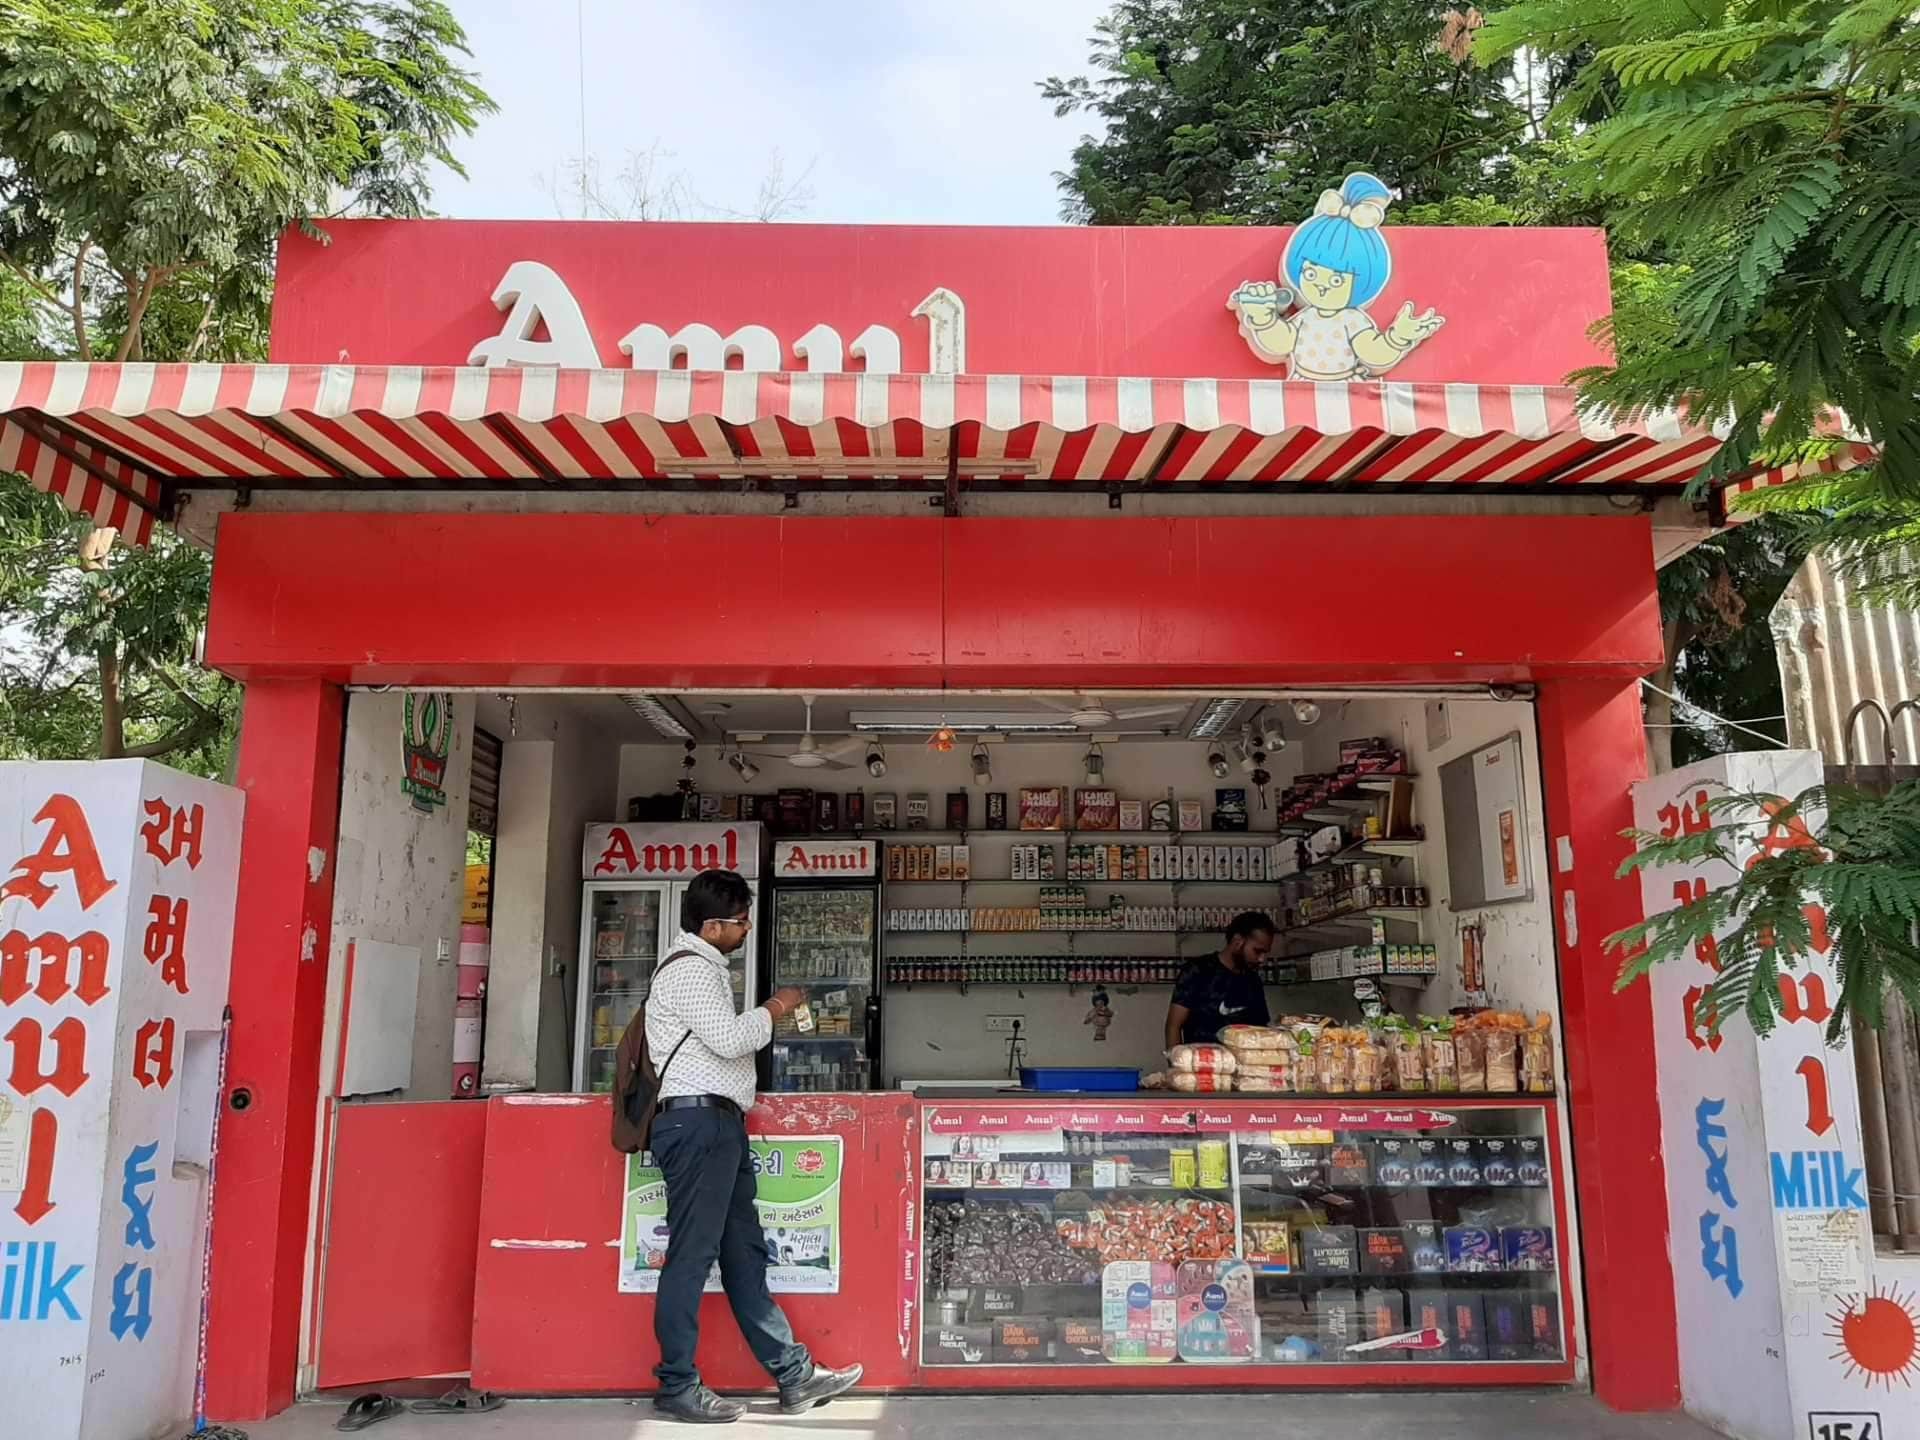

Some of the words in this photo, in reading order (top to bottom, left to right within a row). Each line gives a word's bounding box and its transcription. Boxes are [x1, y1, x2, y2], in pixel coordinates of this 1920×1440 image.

[594, 827, 738, 876] Amul
[783, 846, 869, 871] Amul
[133, 797, 206, 1092] અમૂલ
[0, 793, 118, 1226] Amul
[933, 1114, 963, 1126] Amul
[979, 1114, 1008, 1125] Amul
[1024, 1114, 1053, 1124] Amul
[1070, 1113, 1099, 1124] Amul
[1115, 1114, 1144, 1124] Amul
[1160, 1114, 1185, 1124] Amu
[1203, 1114, 1232, 1124] Amul
[1248, 1113, 1277, 1123] Amul
[1294, 1113, 1323, 1123] Amul
[1339, 1113, 1368, 1123] Amul
[1384, 1112, 1413, 1122] Amul
[1770, 1151, 1868, 1208] Milk
[782, 1203, 824, 1222] અહેસાસ
[1695, 1098, 1744, 1300] દૂધ
[109, 1140, 159, 1343] દૂધ
[905, 1250, 914, 1280] Amul
[1246, 1252, 1270, 1263] Amul
[0, 1241, 85, 1321] ilk
[1205, 1291, 1225, 1300] Amul
[1003, 1327, 1024, 1337] DARK
[1065, 1327, 1087, 1335] DARK
